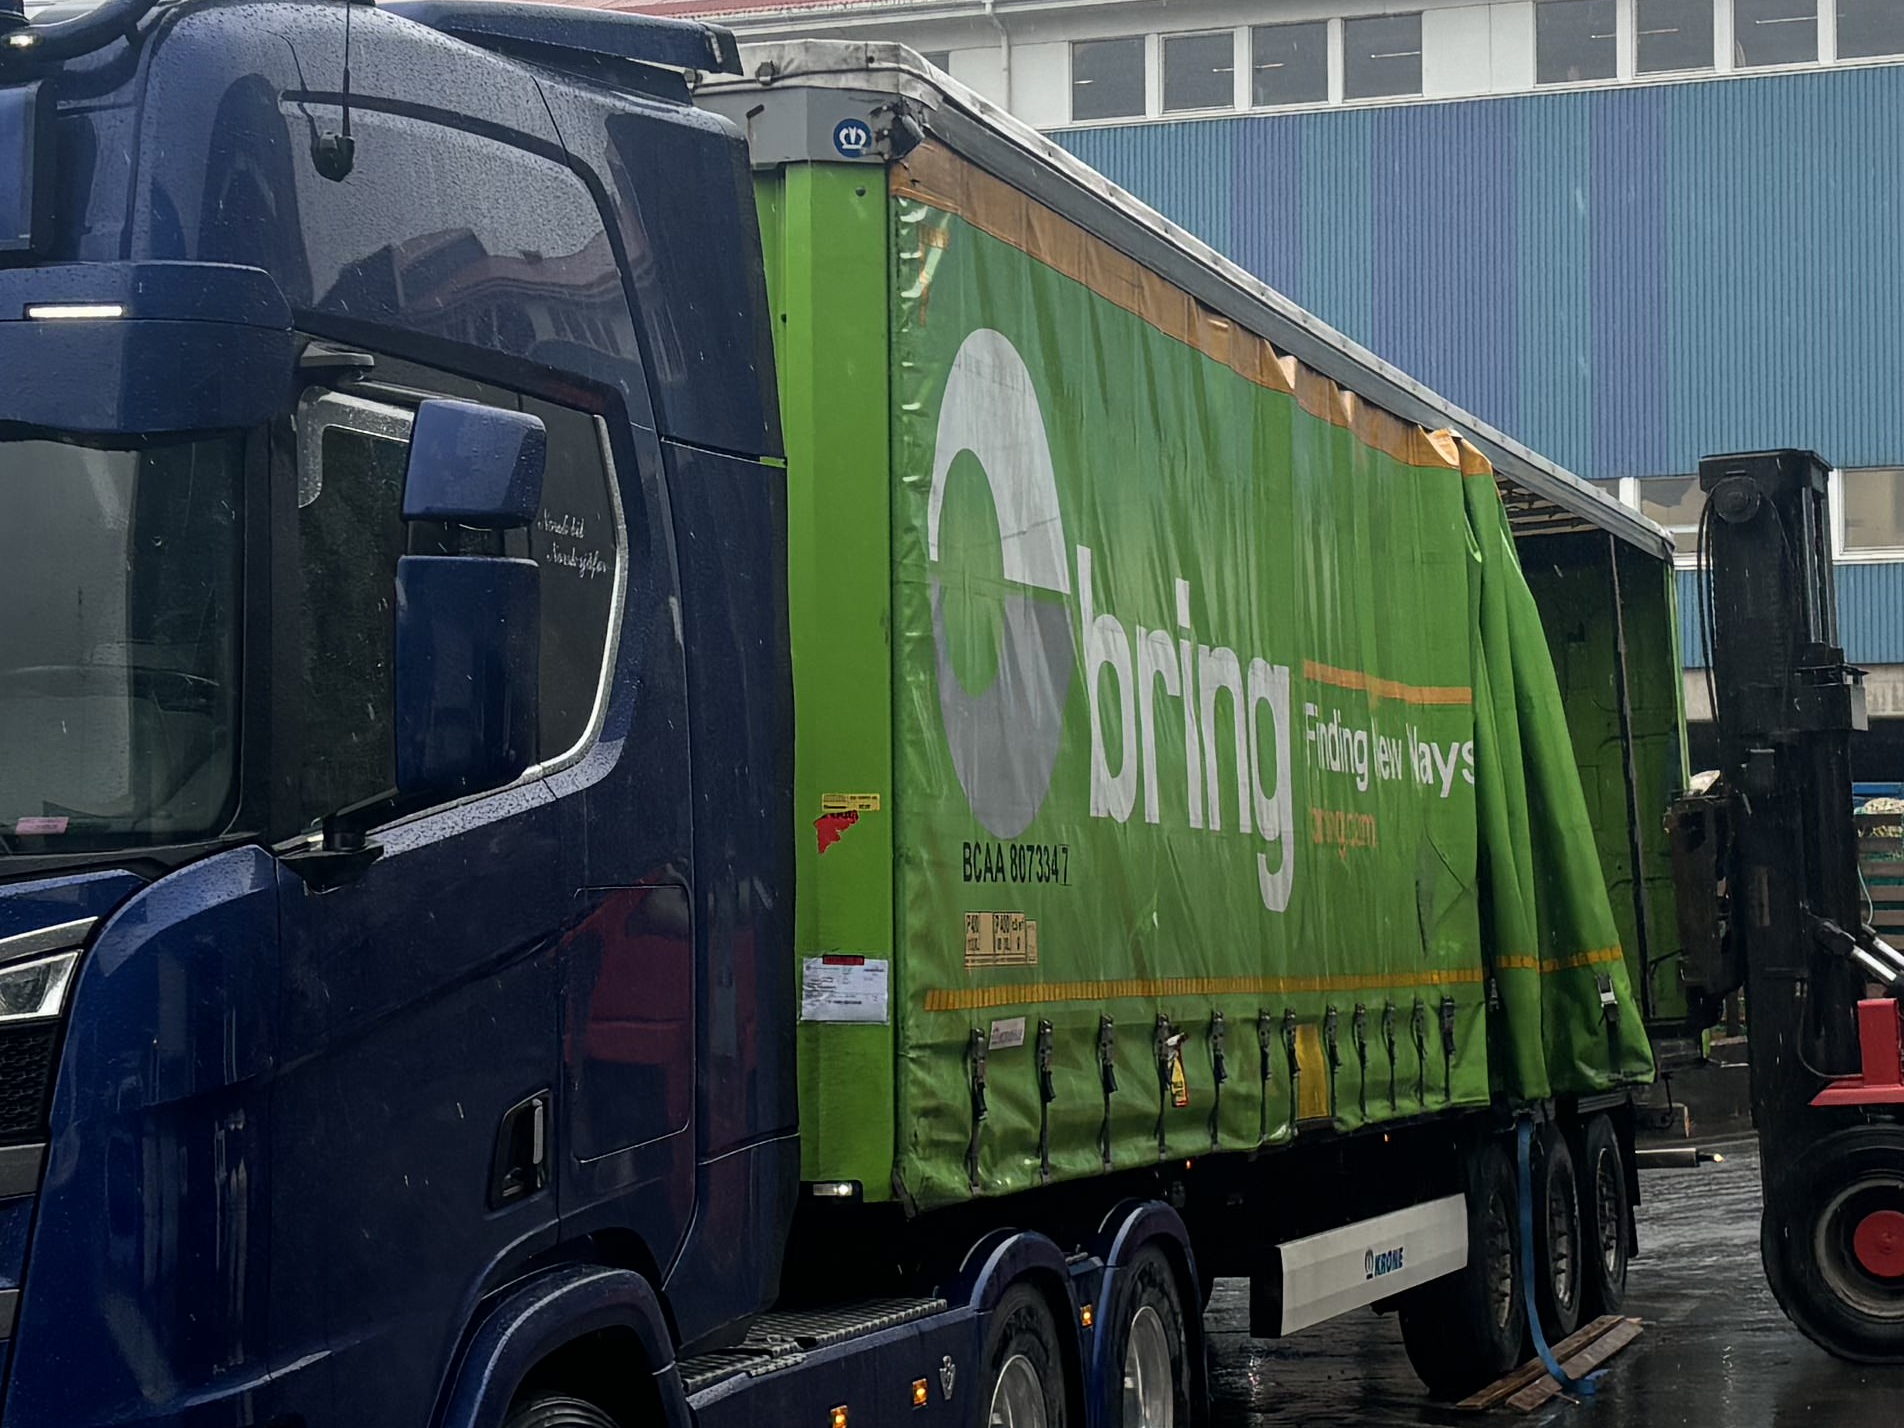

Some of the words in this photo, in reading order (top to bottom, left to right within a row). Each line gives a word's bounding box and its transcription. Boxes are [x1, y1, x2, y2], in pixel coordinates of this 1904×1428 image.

[1076, 544, 1294, 912] bring
[1304, 702, 1369, 792] Finding
[962, 841, 1006, 883] BCAA
[1010, 843, 1070, 885] 8073347
